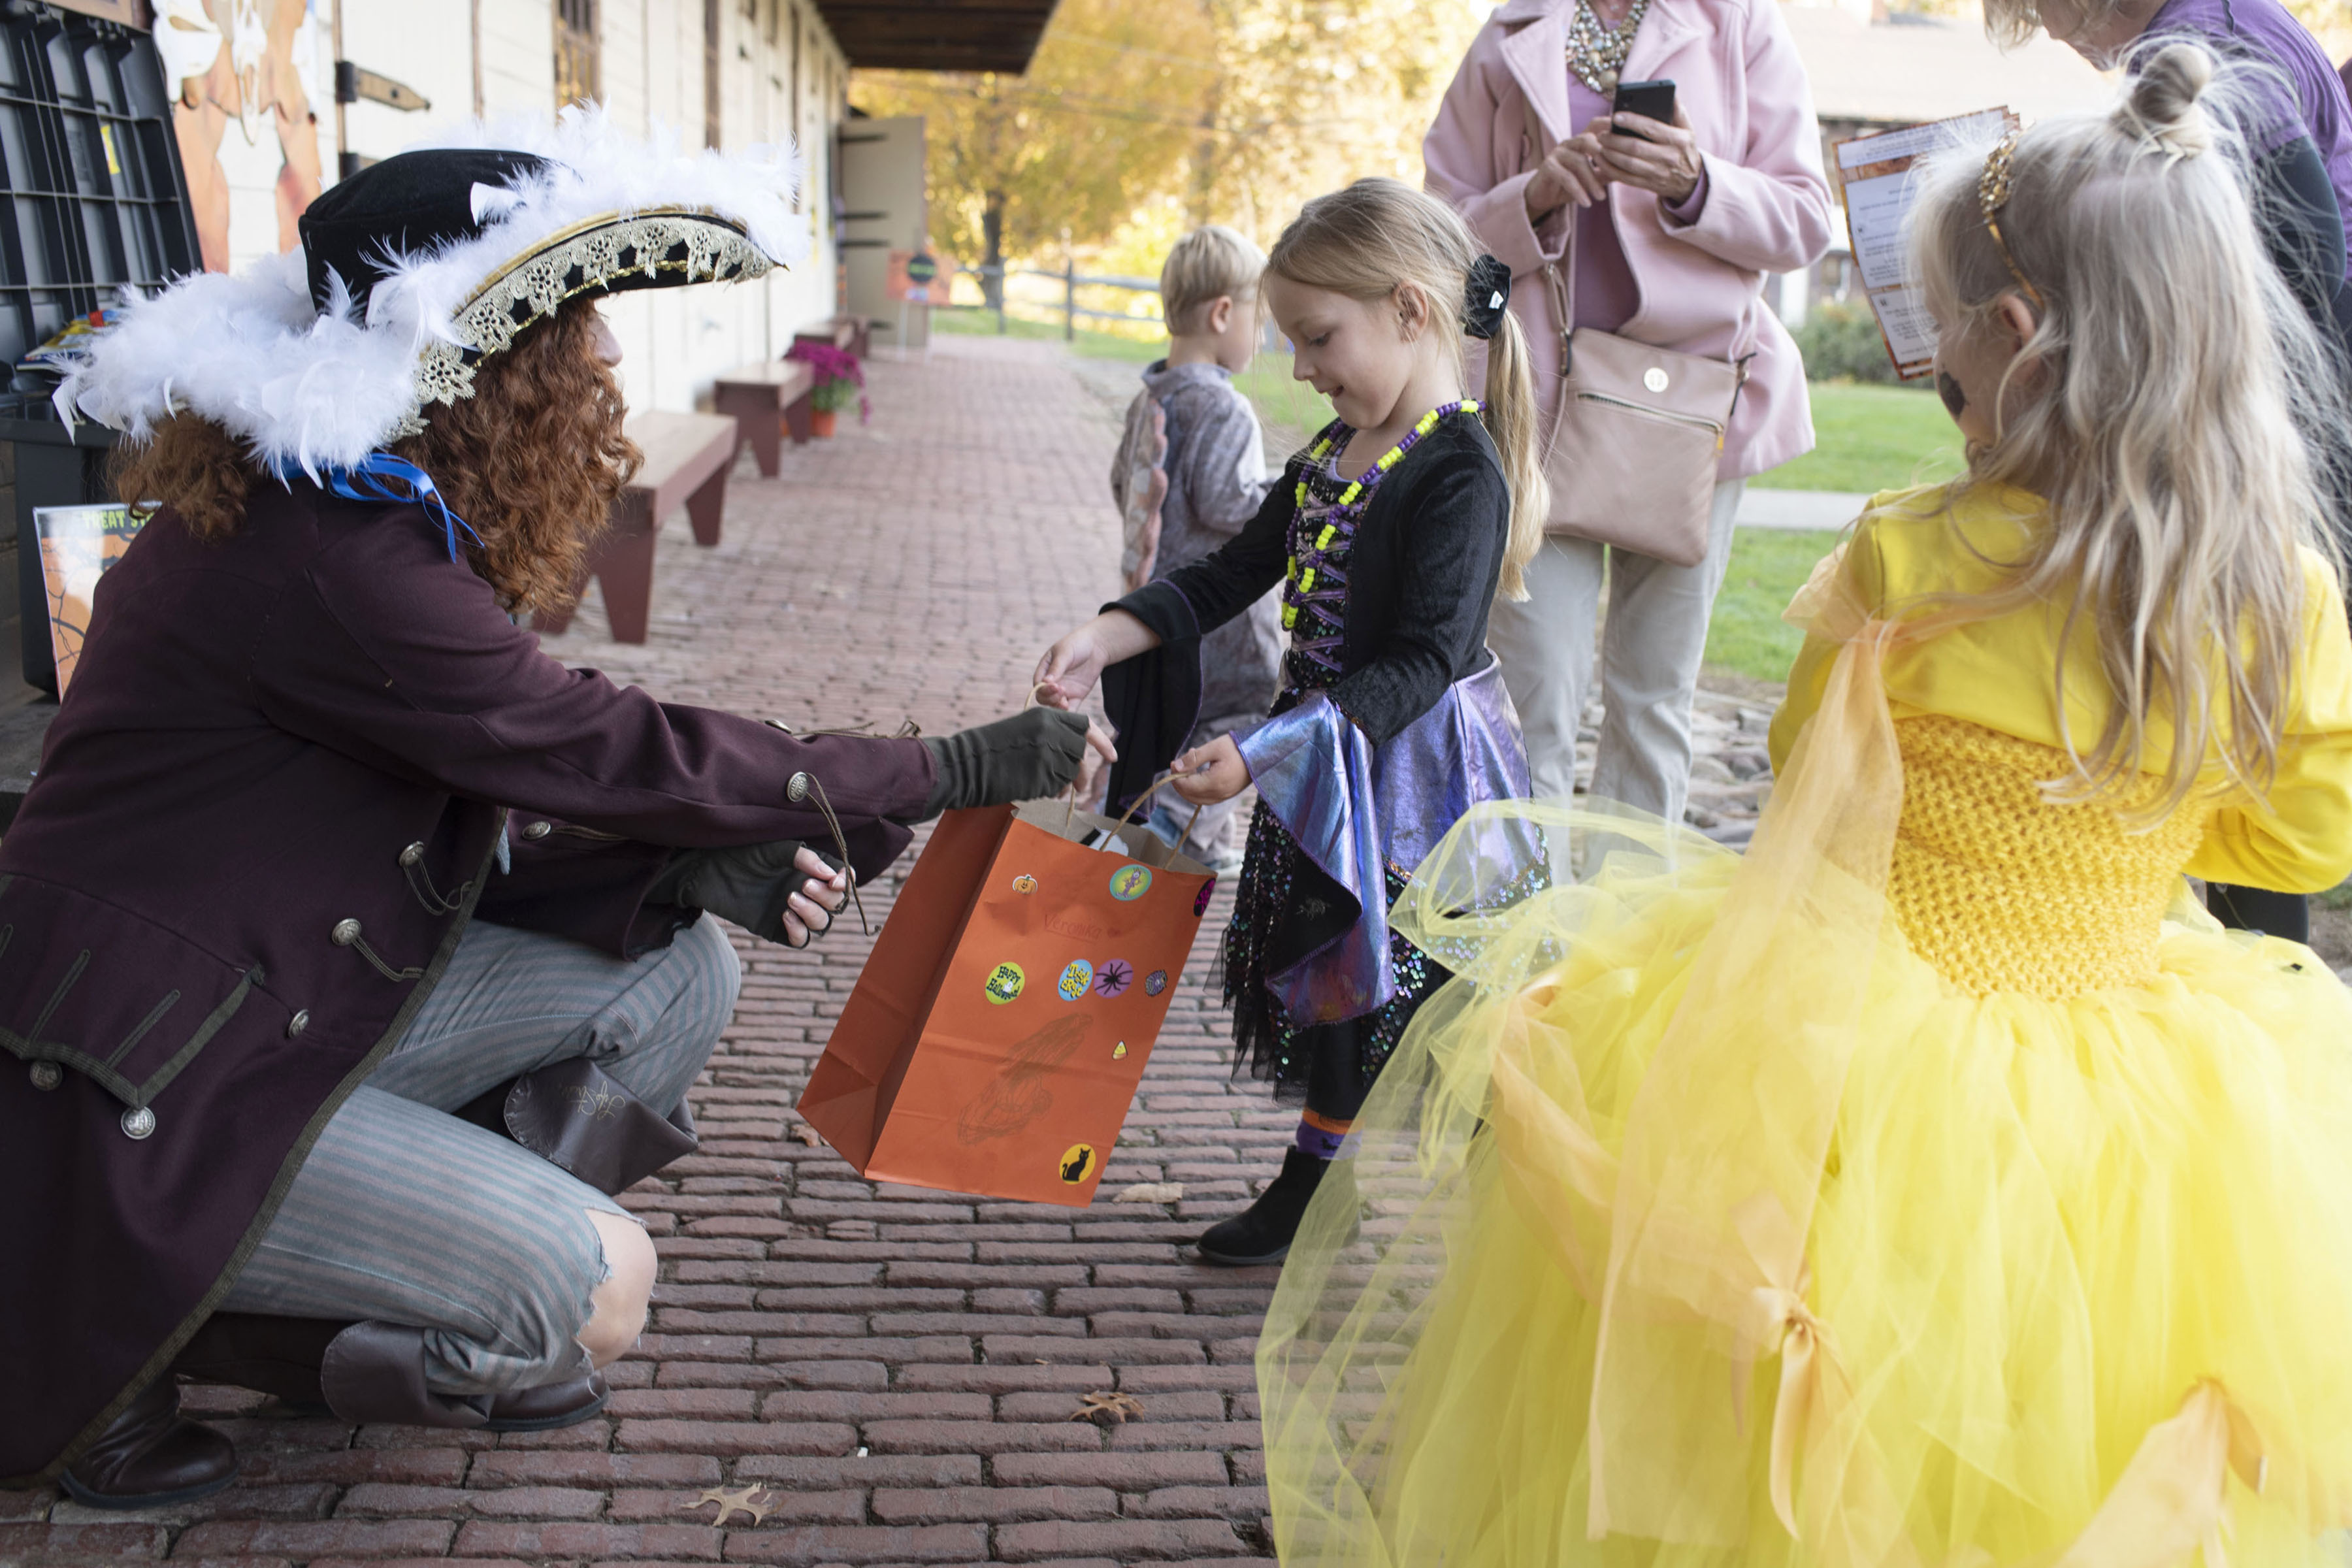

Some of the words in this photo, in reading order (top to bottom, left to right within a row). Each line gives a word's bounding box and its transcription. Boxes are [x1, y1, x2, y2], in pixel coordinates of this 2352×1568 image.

[82, 510, 125, 530] TREAT
[1044, 913, 1103, 940] Veronika
[997, 966, 1021, 985] Happy
[1067, 964, 1090, 986] Trick
